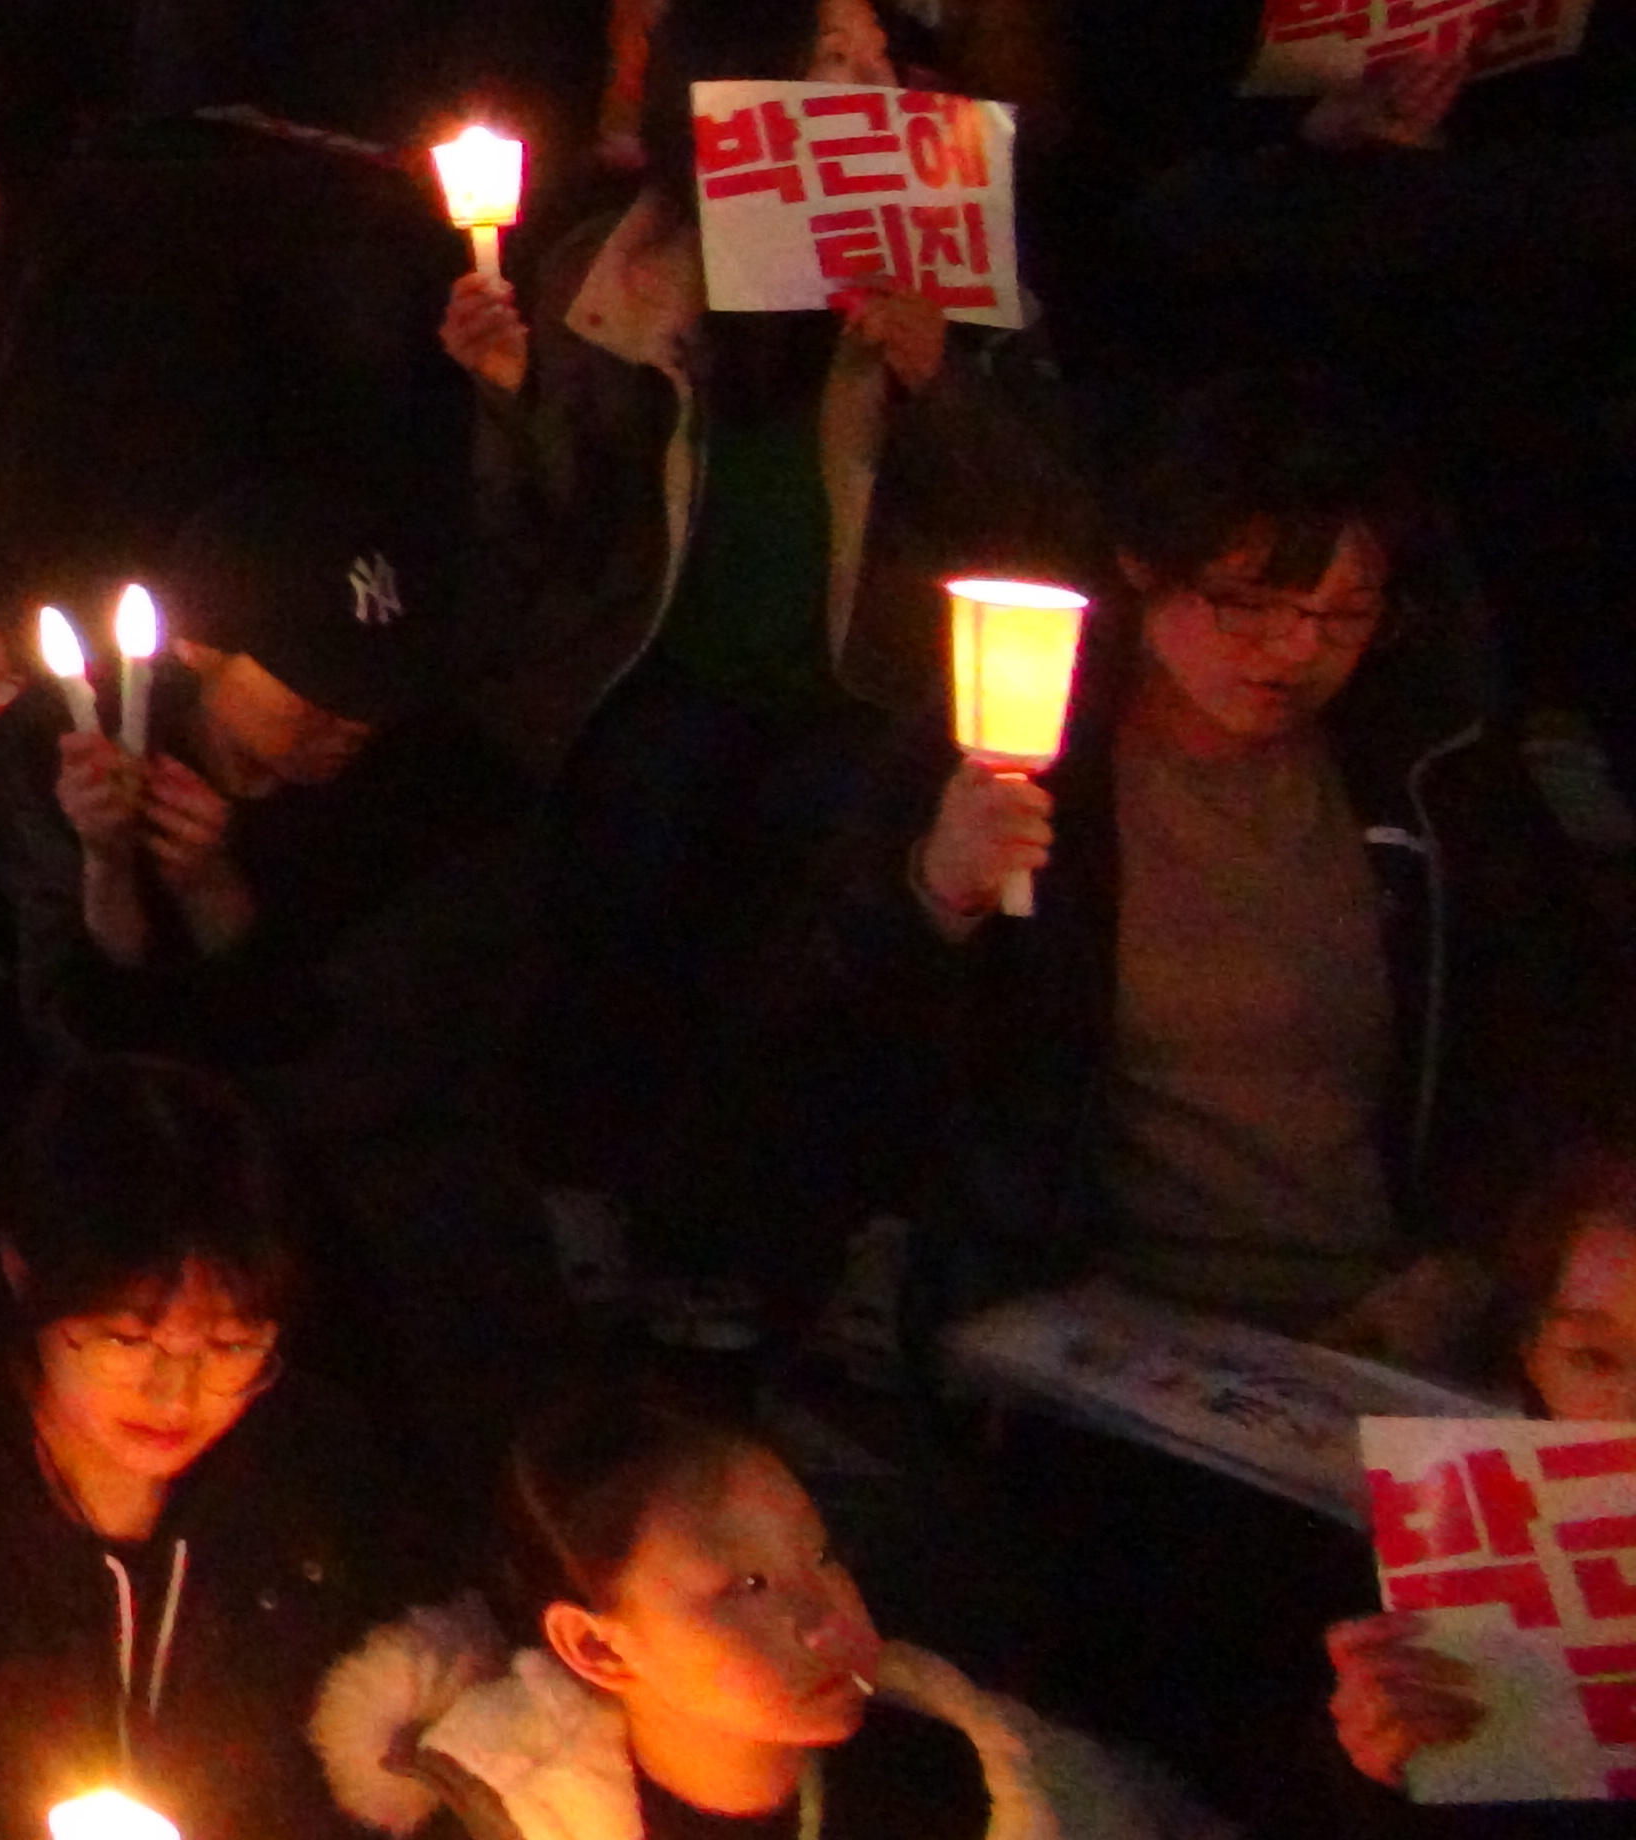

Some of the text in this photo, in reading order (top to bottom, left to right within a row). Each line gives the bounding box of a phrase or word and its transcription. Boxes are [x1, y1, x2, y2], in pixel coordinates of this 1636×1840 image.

[693, 92, 989, 203] 박근혜
[809, 203, 996, 317] 퇴진
[347, 548, 405, 625] NY
